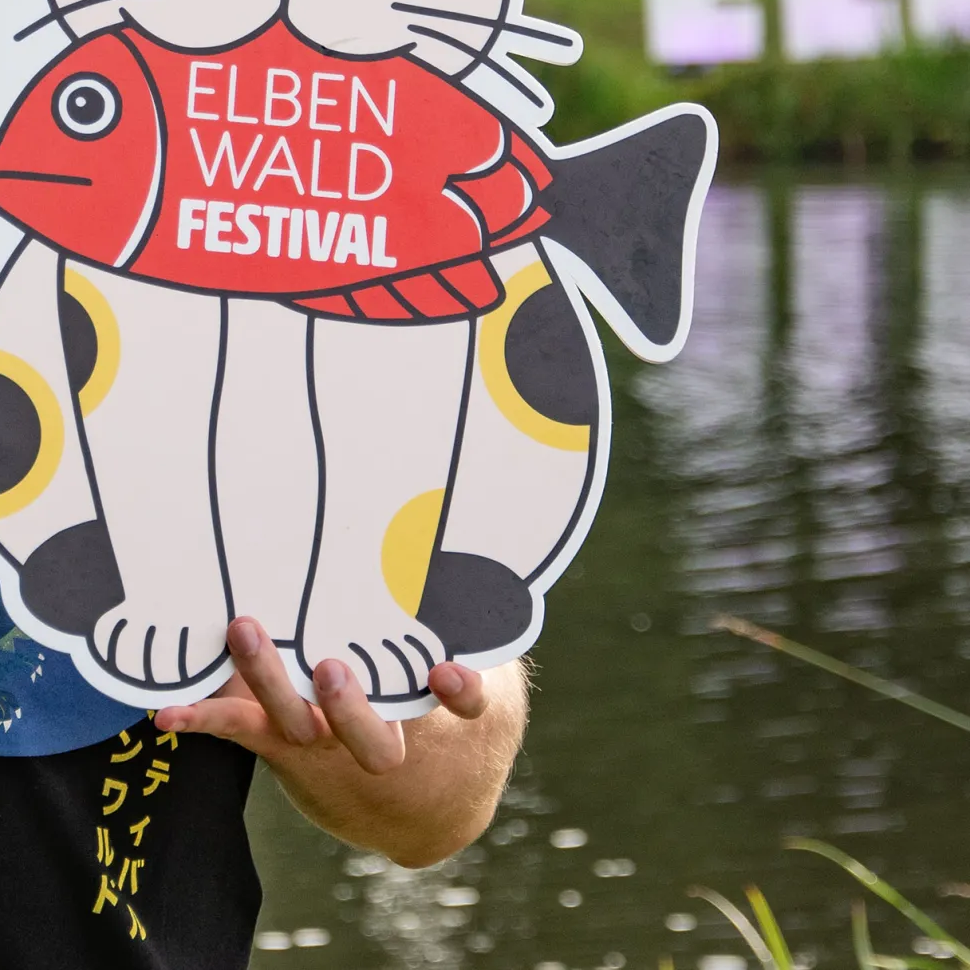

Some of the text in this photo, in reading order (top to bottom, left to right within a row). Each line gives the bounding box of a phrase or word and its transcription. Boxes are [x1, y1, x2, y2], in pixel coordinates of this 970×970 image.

[187, 61, 396, 137] ELBEN
[190, 127, 393, 201] WALD
[177, 198, 398, 268] FESTIVAL
